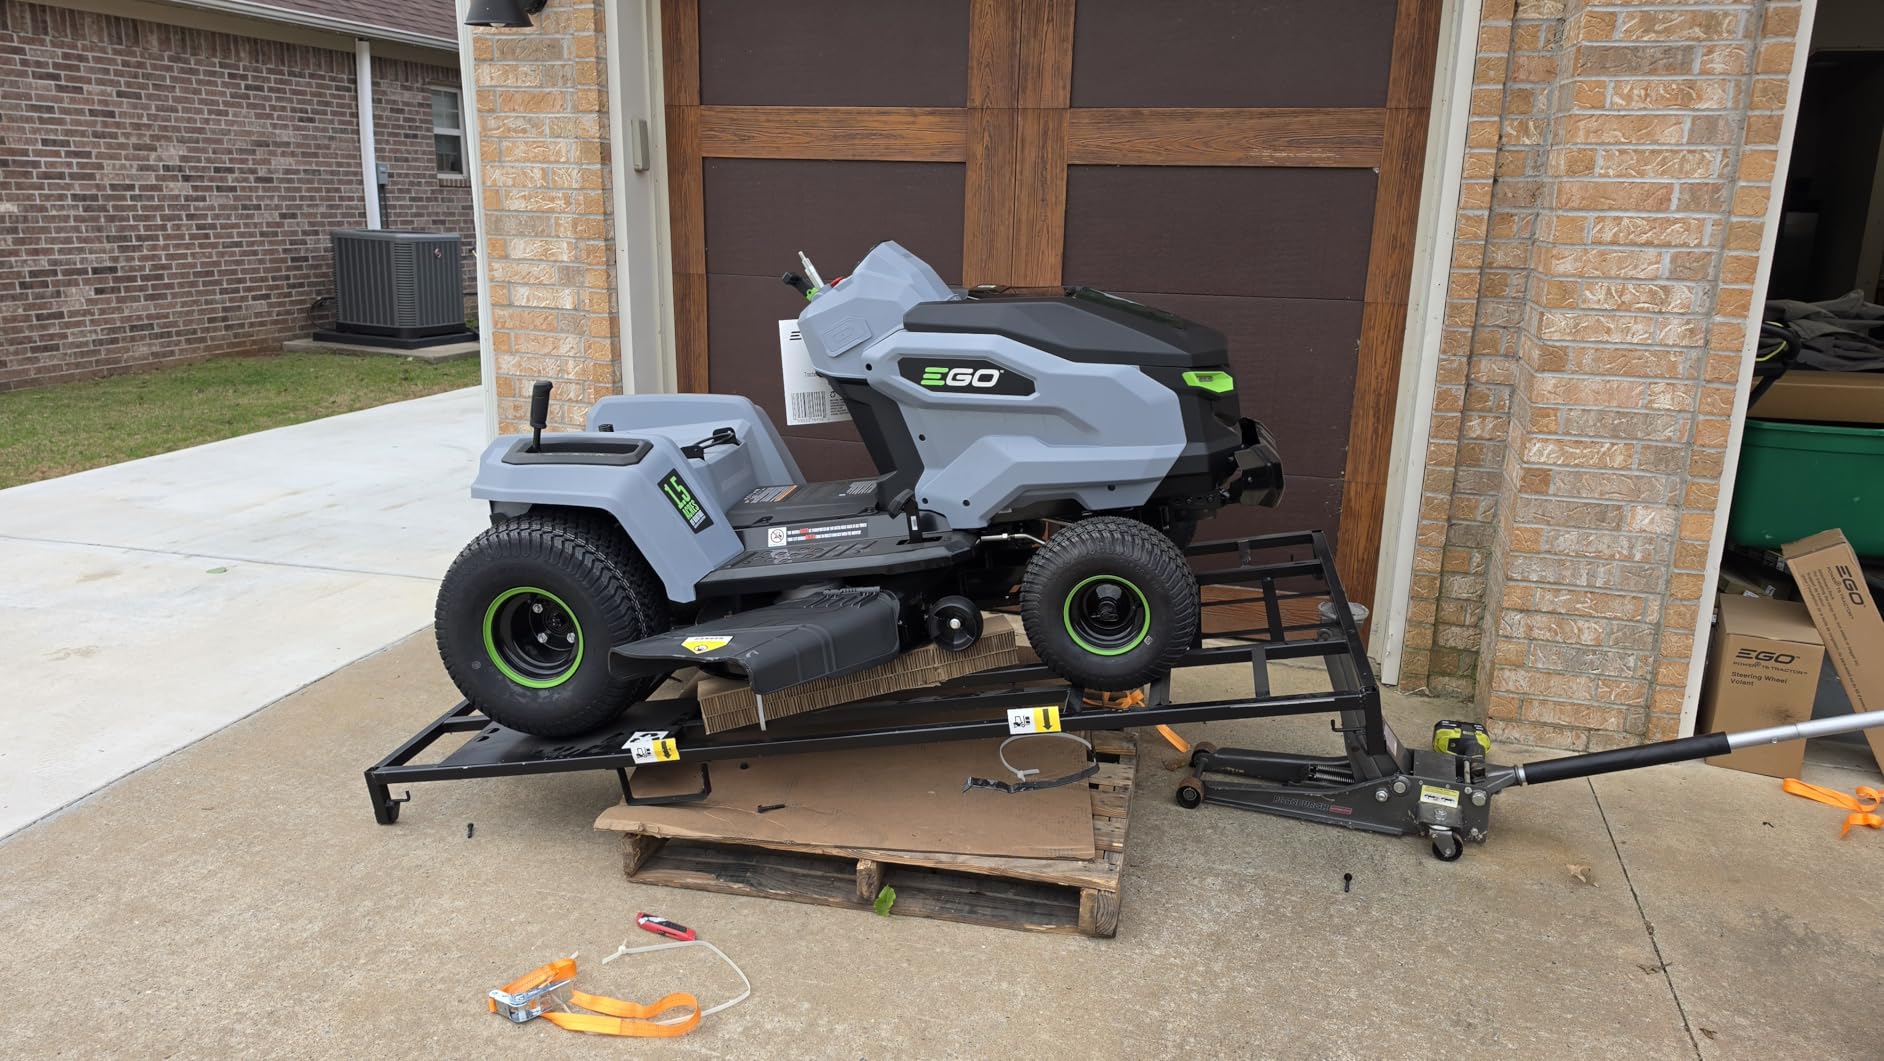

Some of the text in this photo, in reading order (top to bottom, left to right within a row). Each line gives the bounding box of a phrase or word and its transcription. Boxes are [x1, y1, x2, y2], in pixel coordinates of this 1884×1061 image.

[920, 367, 1000, 388] EGO
[664, 476, 691, 510] 1.5
[1835, 565, 1864, 606] EGO
[1735, 648, 1796, 665] EGO
[1730, 679, 1754, 687] Volant
[1731, 672, 1788, 684] Steering Wheel
